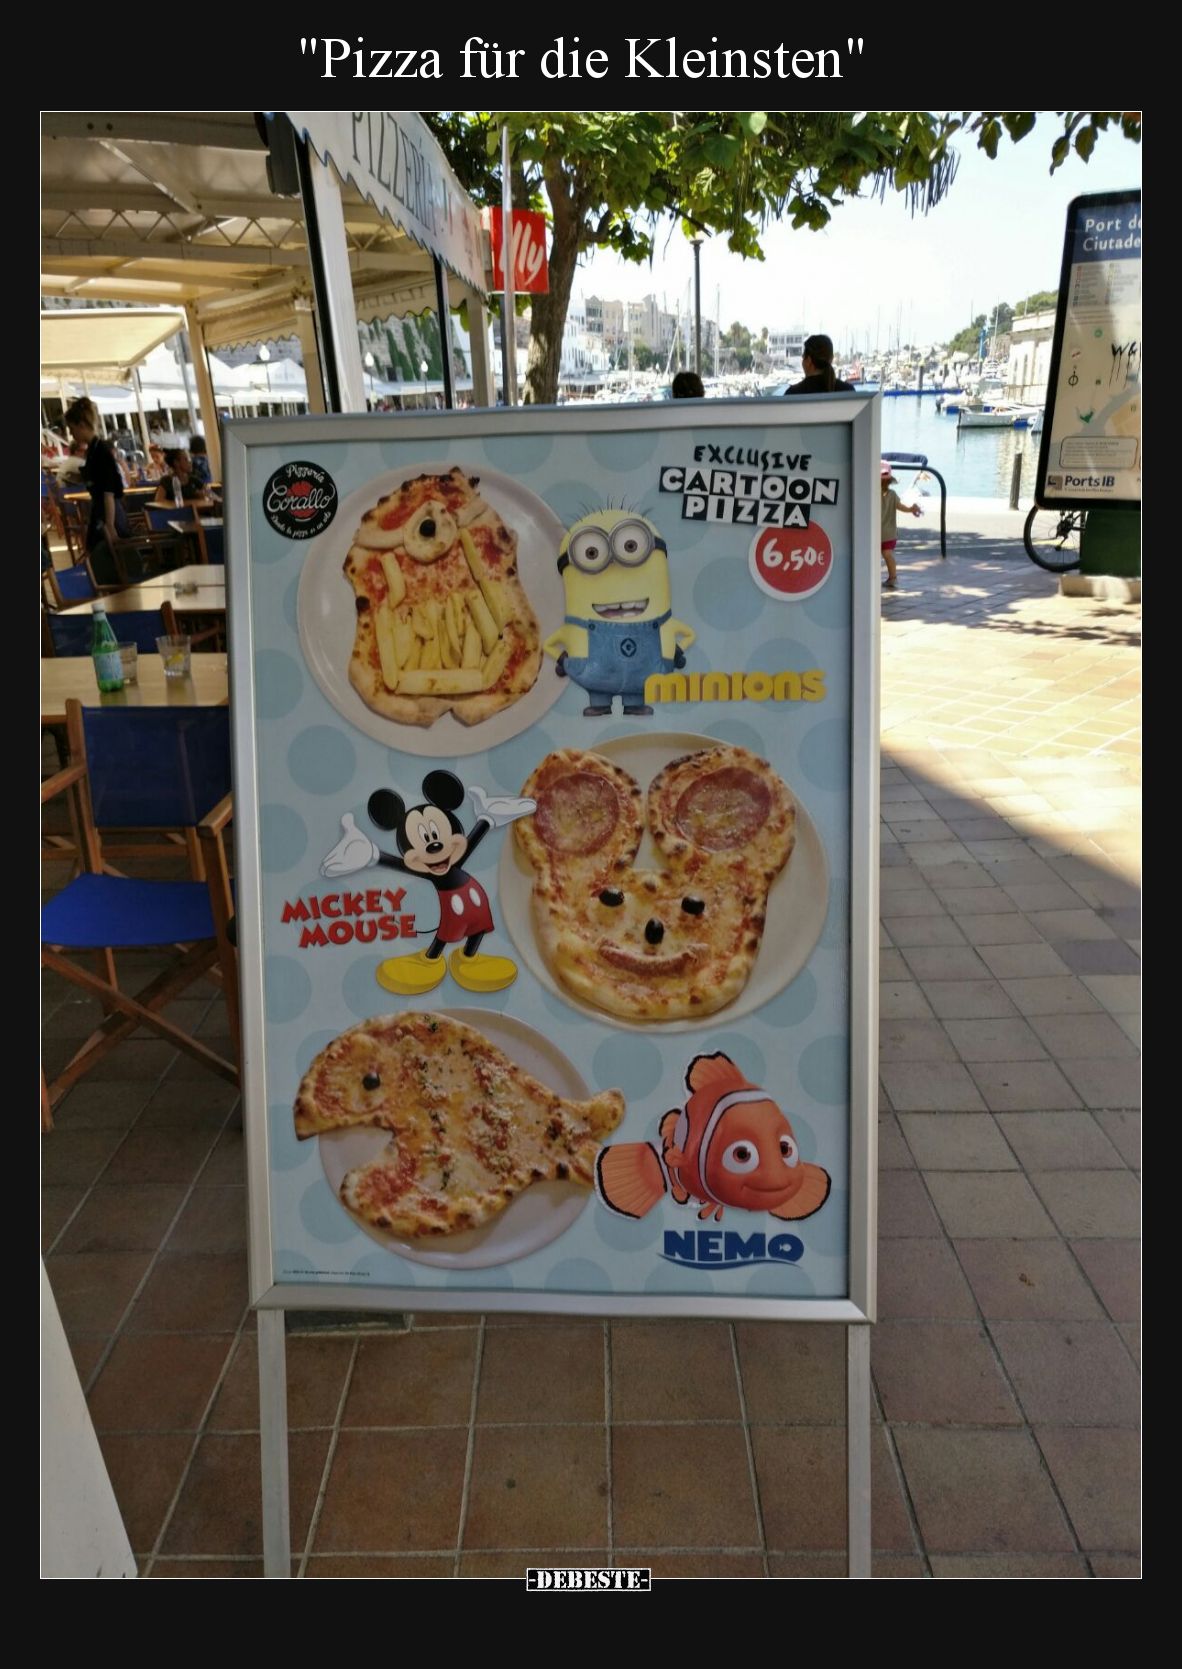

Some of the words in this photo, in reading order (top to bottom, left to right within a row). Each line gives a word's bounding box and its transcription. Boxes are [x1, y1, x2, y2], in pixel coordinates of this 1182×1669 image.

[1083, 232, 1141, 252] Ciutade
[1085, 218, 1122, 232] Port
[694, 444, 812, 471] EXCLUSIVE
[267, 476, 336, 512] Corallo
[660, 467, 839, 504] CARTOON
[683, 494, 811, 529] PIZZA
[762, 538, 825, 571] 6,50€
[644, 669, 828, 703] minions
[281, 886, 407, 924] MICKEY
[299, 914, 418, 948] MOUSE
[664, 1230, 804, 1262] NEMO
